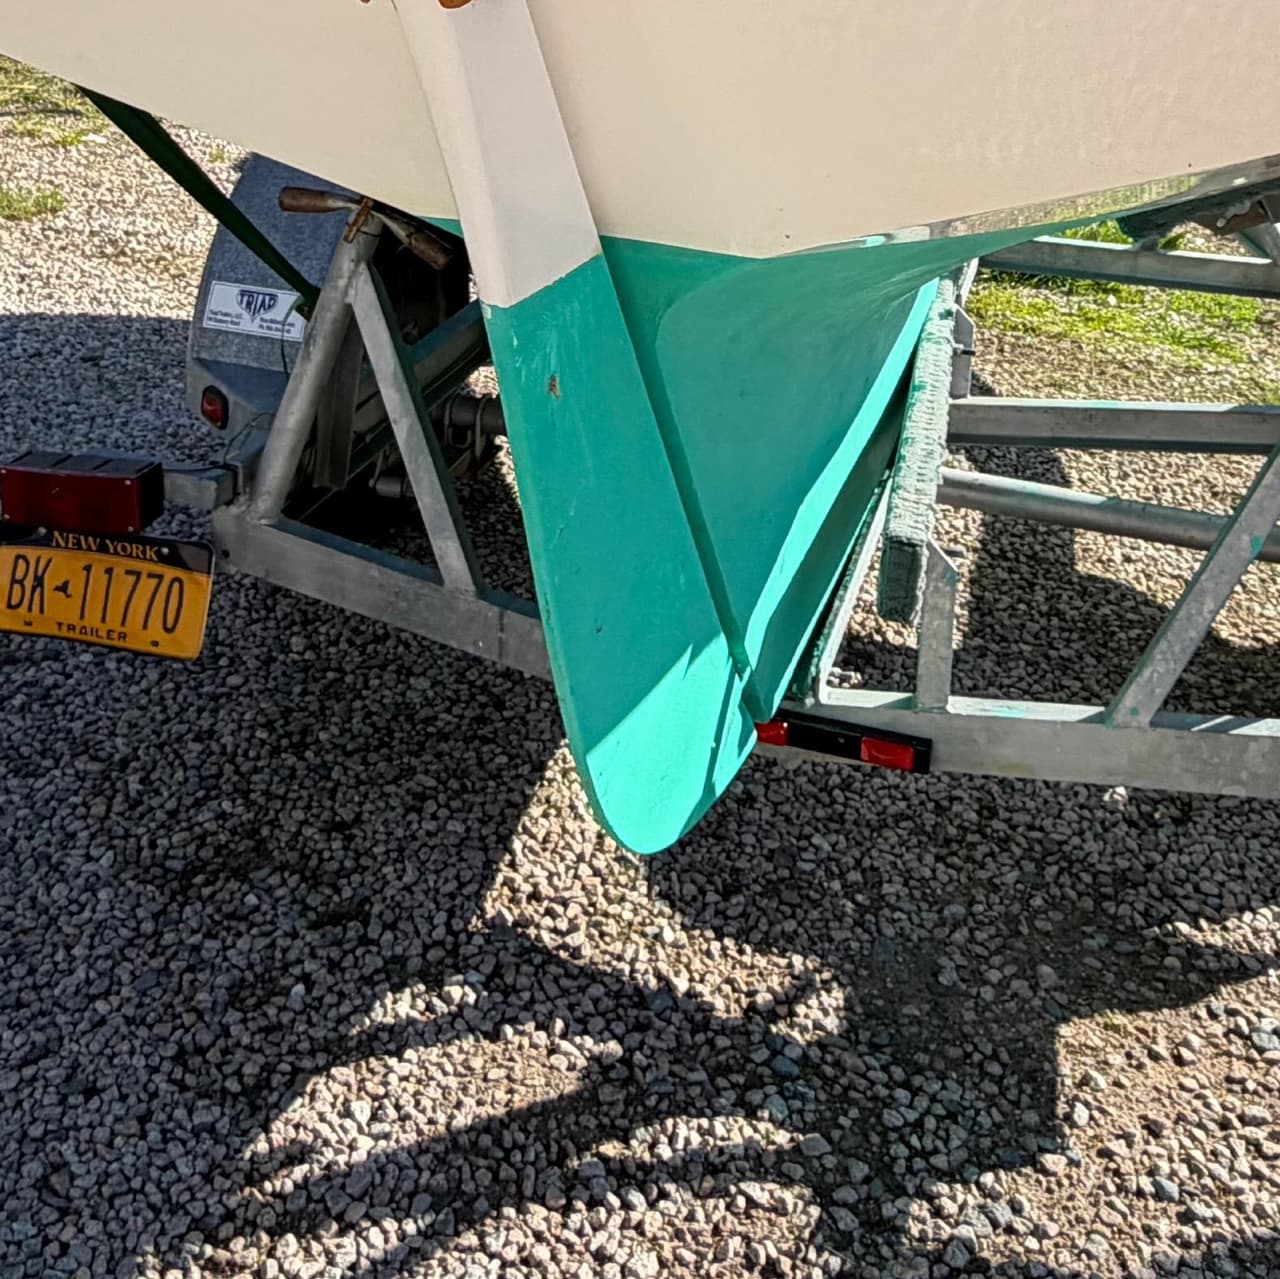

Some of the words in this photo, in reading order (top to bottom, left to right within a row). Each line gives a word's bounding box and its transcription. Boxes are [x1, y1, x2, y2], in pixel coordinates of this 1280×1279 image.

[237, 289, 279, 317] TRIAD
[51, 530, 101, 551] NEW
[106, 538, 160, 561] YORK
[6, 553, 52, 615] BK
[78, 563, 185, 634] 11770
[56, 621, 128, 642] TRAILER
